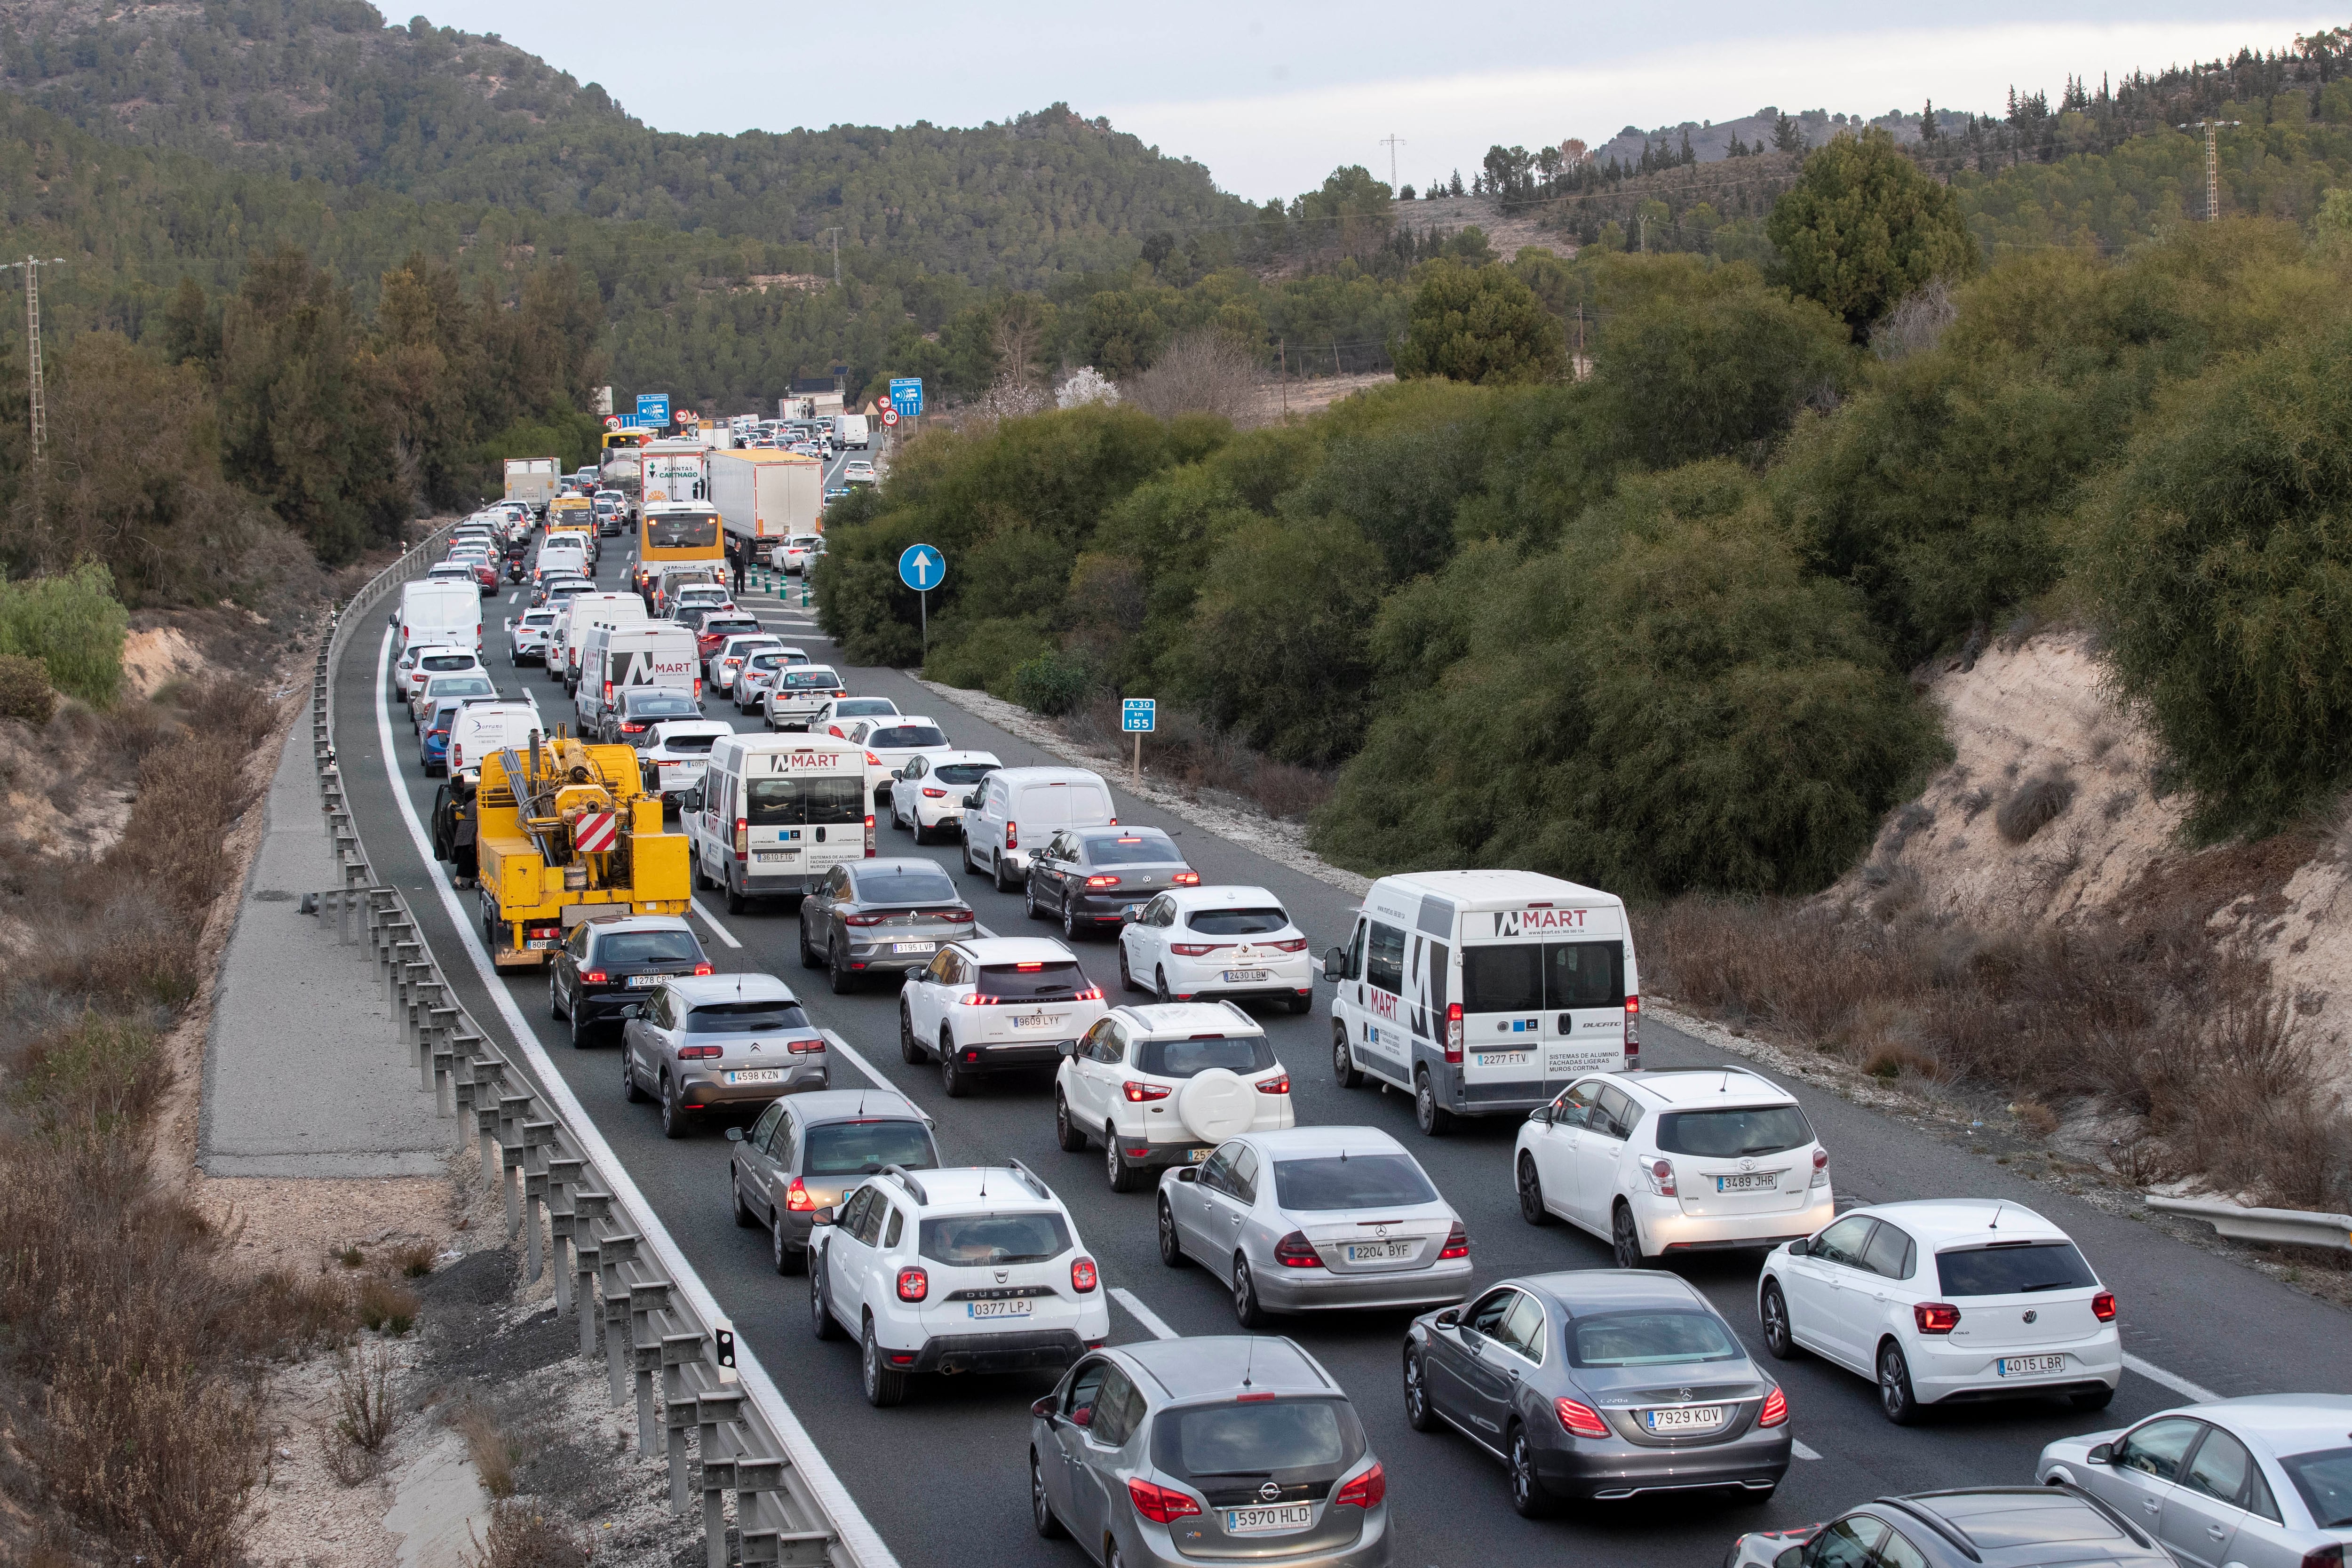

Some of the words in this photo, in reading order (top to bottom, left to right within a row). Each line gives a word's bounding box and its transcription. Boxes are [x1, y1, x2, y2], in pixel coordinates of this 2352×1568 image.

[586, 651, 597, 672] MART
[655, 663, 691, 673] MART
[1128, 719, 1149, 728] 155
[792, 755, 839, 767] MART
[708, 815, 718, 836] MART
[1523, 910, 1587, 928] MART
[635, 976, 654, 985] 1278
[1371, 987, 1398, 1021] MART
[1019, 1017, 1041, 1026] 9609
[1043, 1016, 1059, 1025] LYY
[1484, 1055, 1506, 1064] 2277
[1509, 1054, 1526, 1063] FTV
[737, 1072, 759, 1080] 4598
[762, 1071, 779, 1079] KZN
[1725, 1177, 1751, 1188] 3489
[1755, 1176, 1773, 1186] JHR
[1356, 1246, 1383, 1259] 2204
[1389, 1244, 1408, 1257] BYF
[967, 1289, 1036, 1297] DUSTER
[975, 1303, 1005, 1315] 0377
[1010, 1301, 1032, 1313] LPJ
[2007, 1359, 2036, 1371] 4015
[2040, 1357, 2061, 1369] LBR
[1657, 1411, 1690, 1425] 7929
[1695, 1409, 1718, 1422] KDV
[1239, 1510, 1275, 1526] 5970
[1280, 1508, 1308, 1523] HLD
